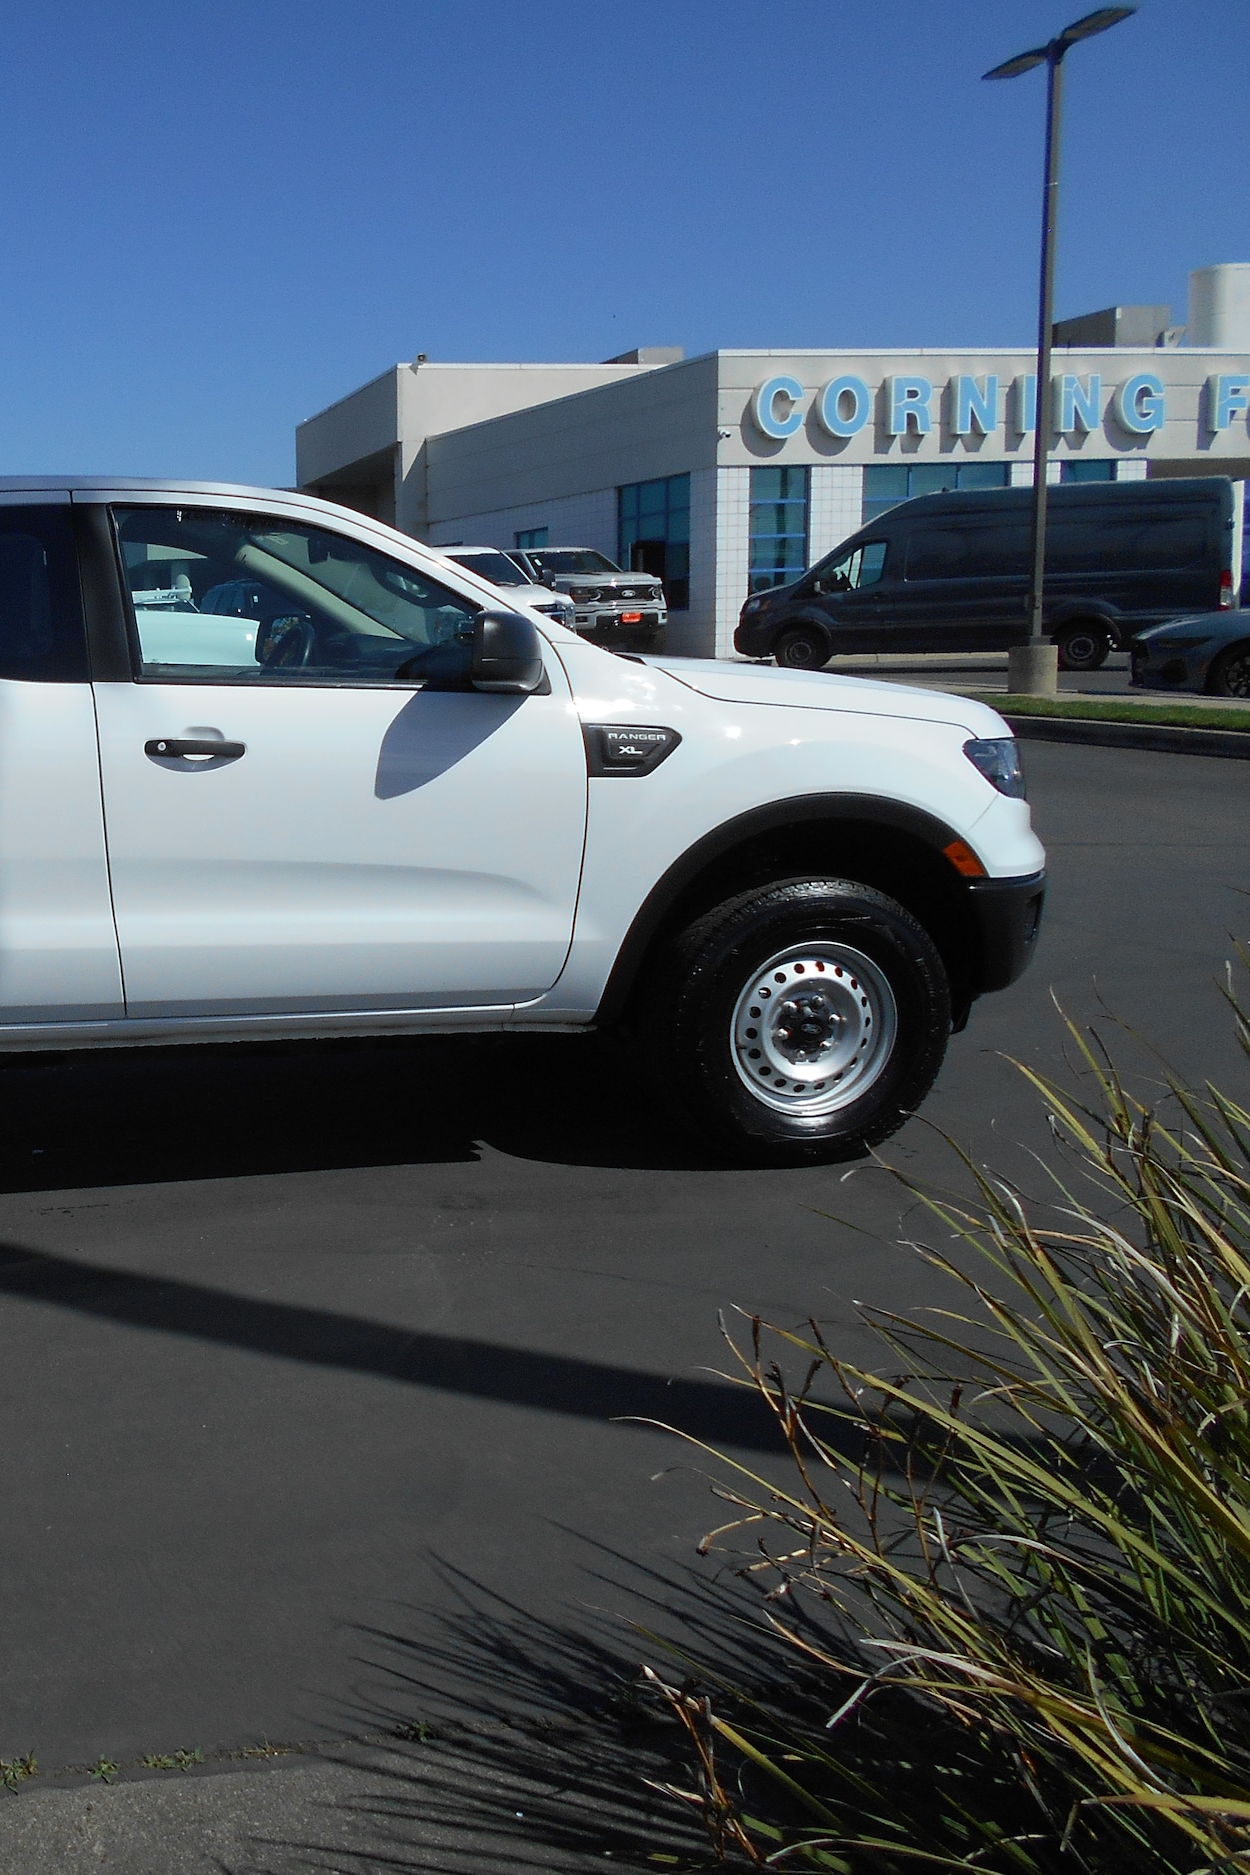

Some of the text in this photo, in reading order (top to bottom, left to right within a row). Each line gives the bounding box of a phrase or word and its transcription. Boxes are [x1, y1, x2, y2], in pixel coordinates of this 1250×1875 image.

[755, 372, 1166, 439] CORNING
[608, 732, 667, 741] RANGER
[618, 745, 643, 755] XL
